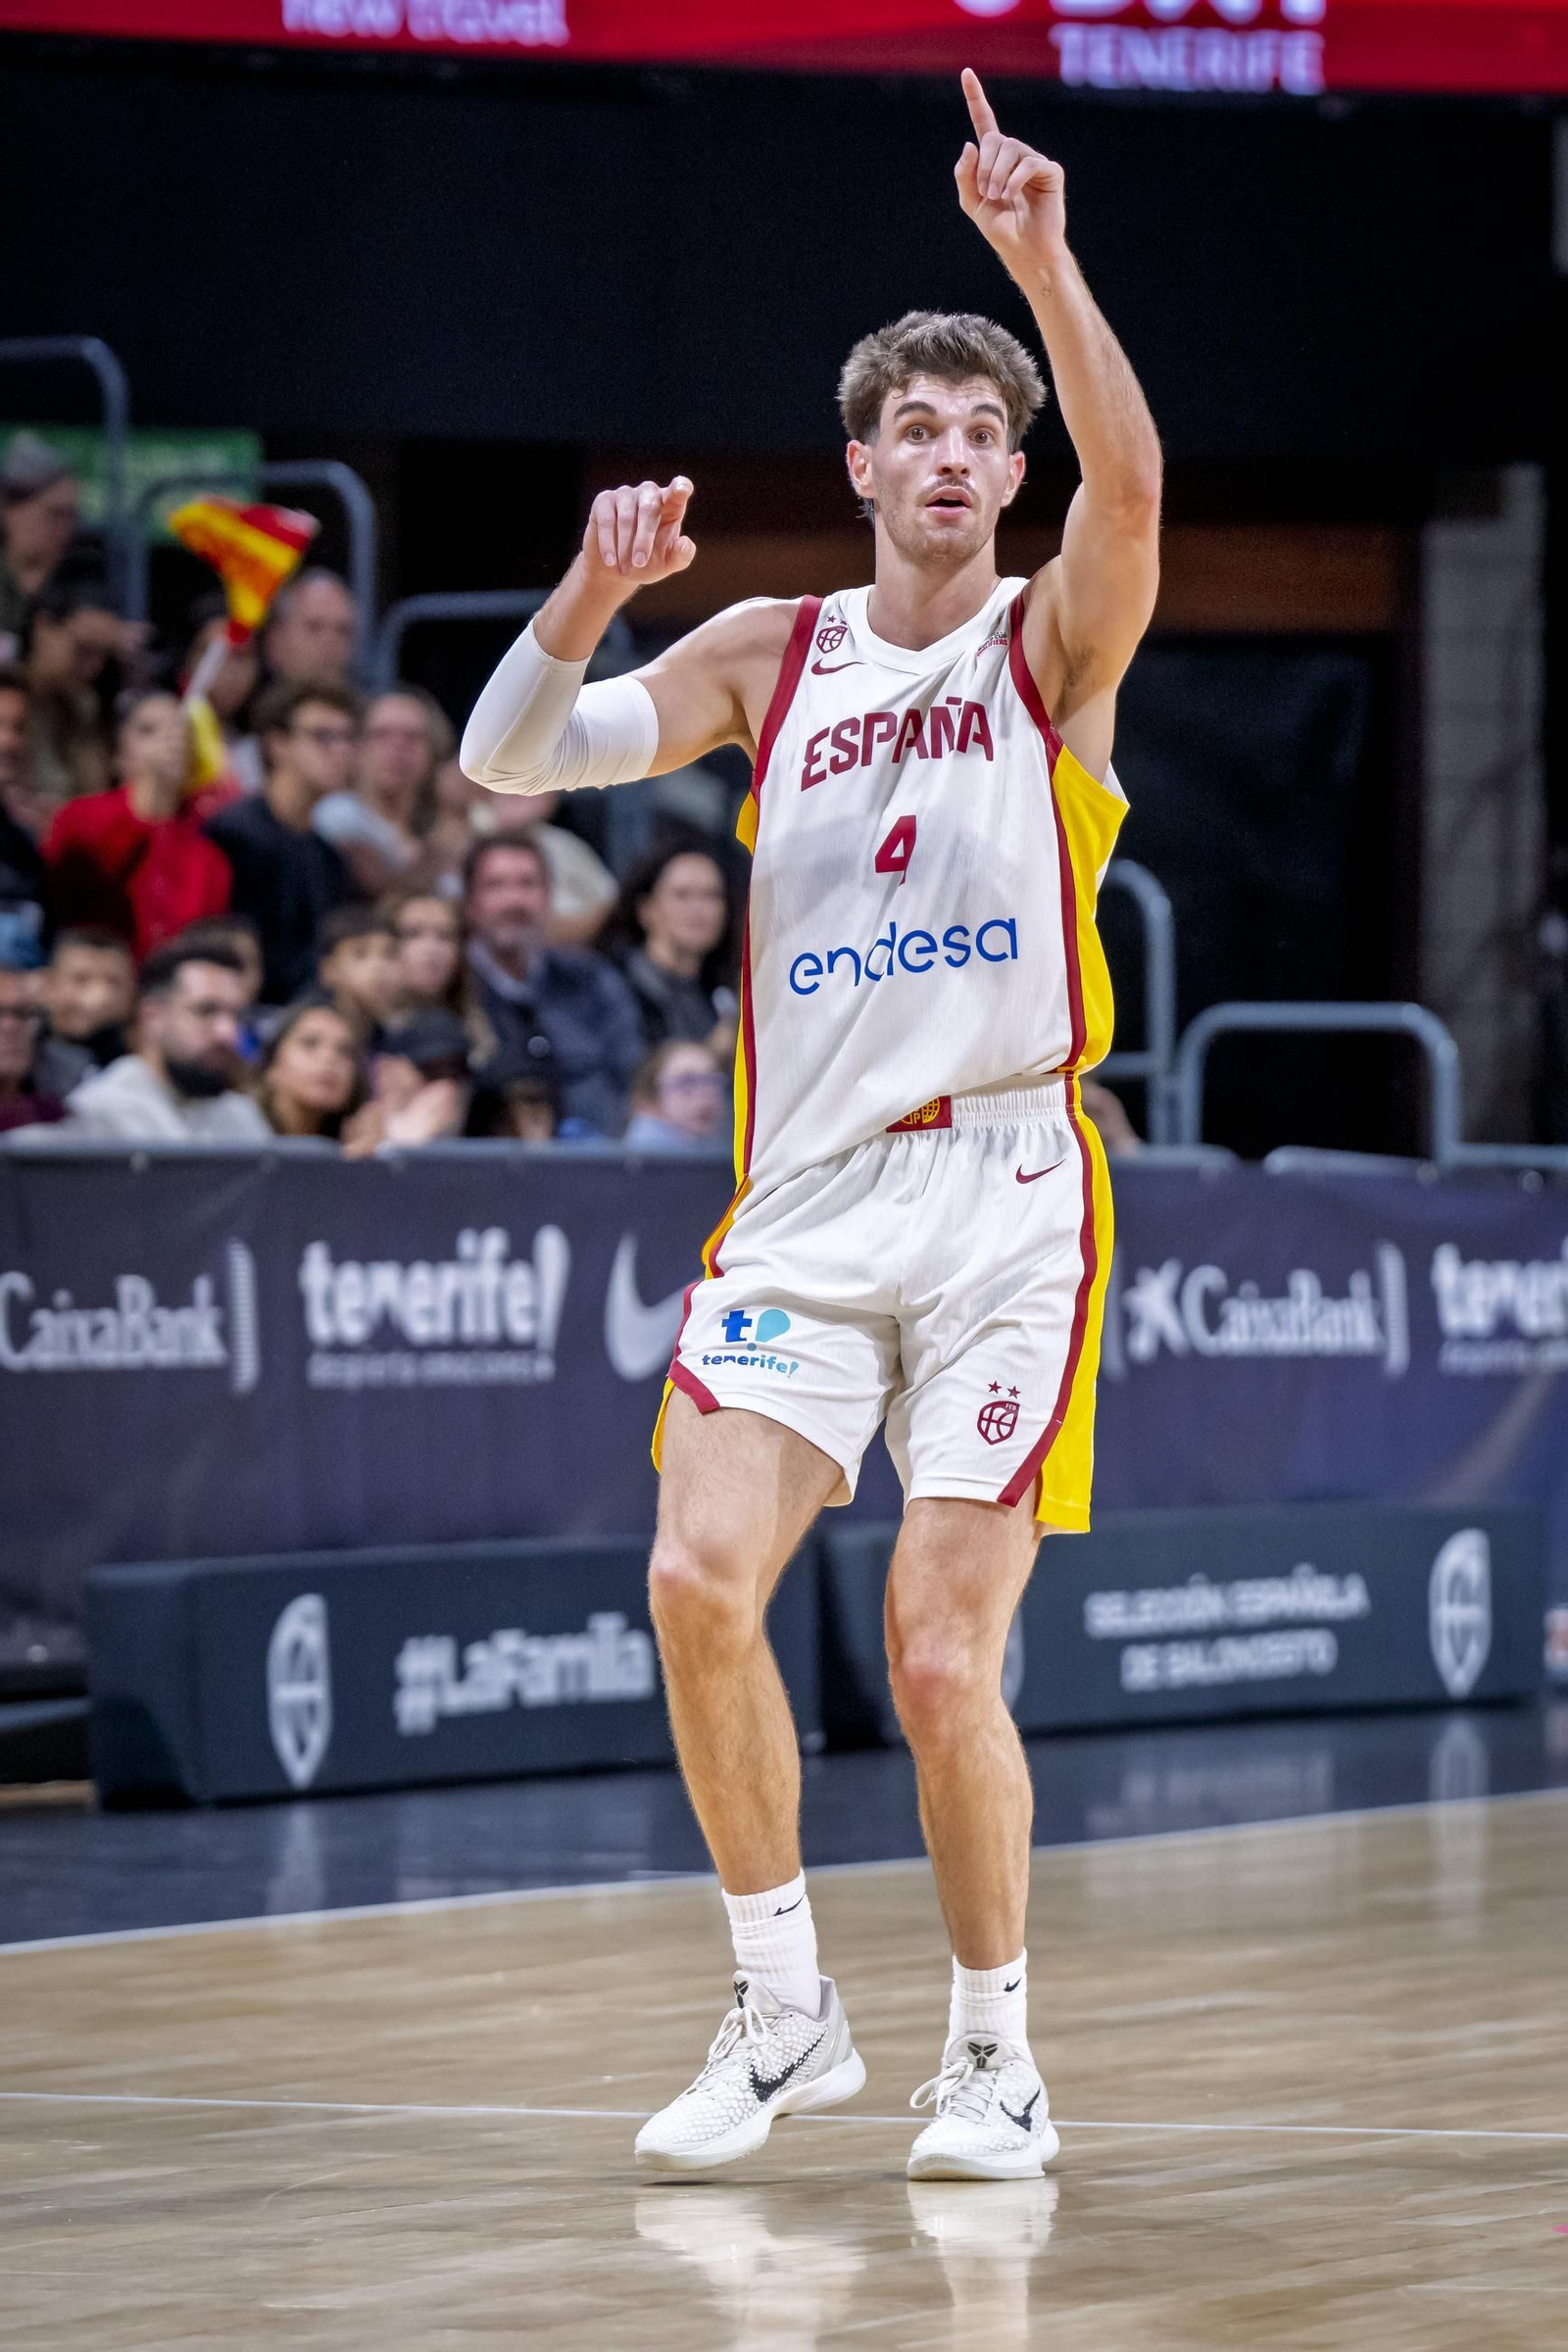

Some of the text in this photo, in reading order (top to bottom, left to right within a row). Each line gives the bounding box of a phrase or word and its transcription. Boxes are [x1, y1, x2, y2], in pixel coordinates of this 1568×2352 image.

[1050, 23, 1325, 94] TENERIFE
[801, 697, 994, 792] ESPAÑA
[875, 814, 917, 885] 4
[789, 917, 1018, 996] endesa
[0, 1272, 224, 1368] CaixaBank
[1182, 1266, 1383, 1356] CaixaBank
